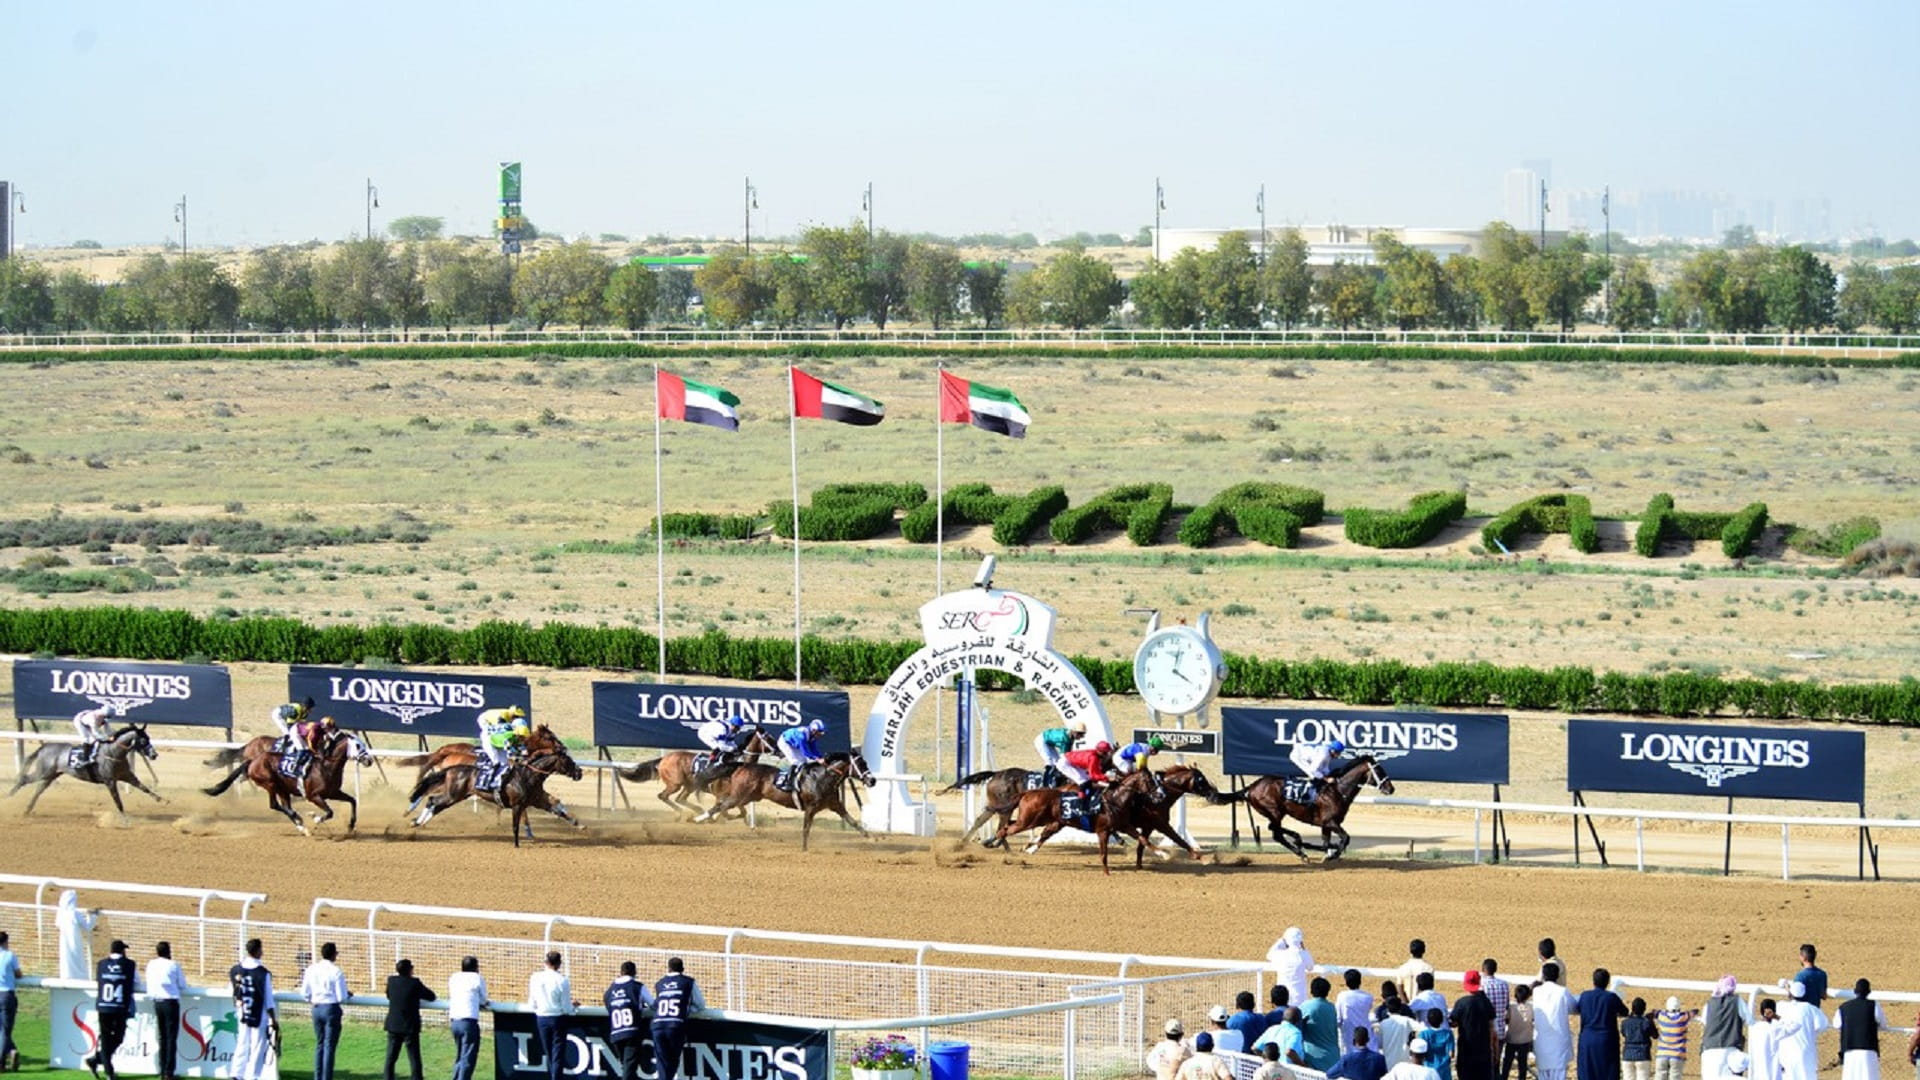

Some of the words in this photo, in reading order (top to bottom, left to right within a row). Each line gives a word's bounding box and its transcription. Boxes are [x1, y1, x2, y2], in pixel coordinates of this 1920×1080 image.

[51, 670, 191, 699] LONGINES
[330, 677, 485, 708] LONGINES
[638, 693, 802, 725] LONGINES
[881, 692, 914, 758] SHARJAH
[1013, 661, 1023, 673] &
[1031, 672, 1077, 720] RACING
[1274, 719, 1458, 751] LONGINES
[1621, 733, 1809, 768] LONGINES
[1062, 801, 1072, 815] 3
[102, 983, 124, 1003] 04
[658, 999, 681, 1017] 05
[611, 1008, 633, 1029] 08
